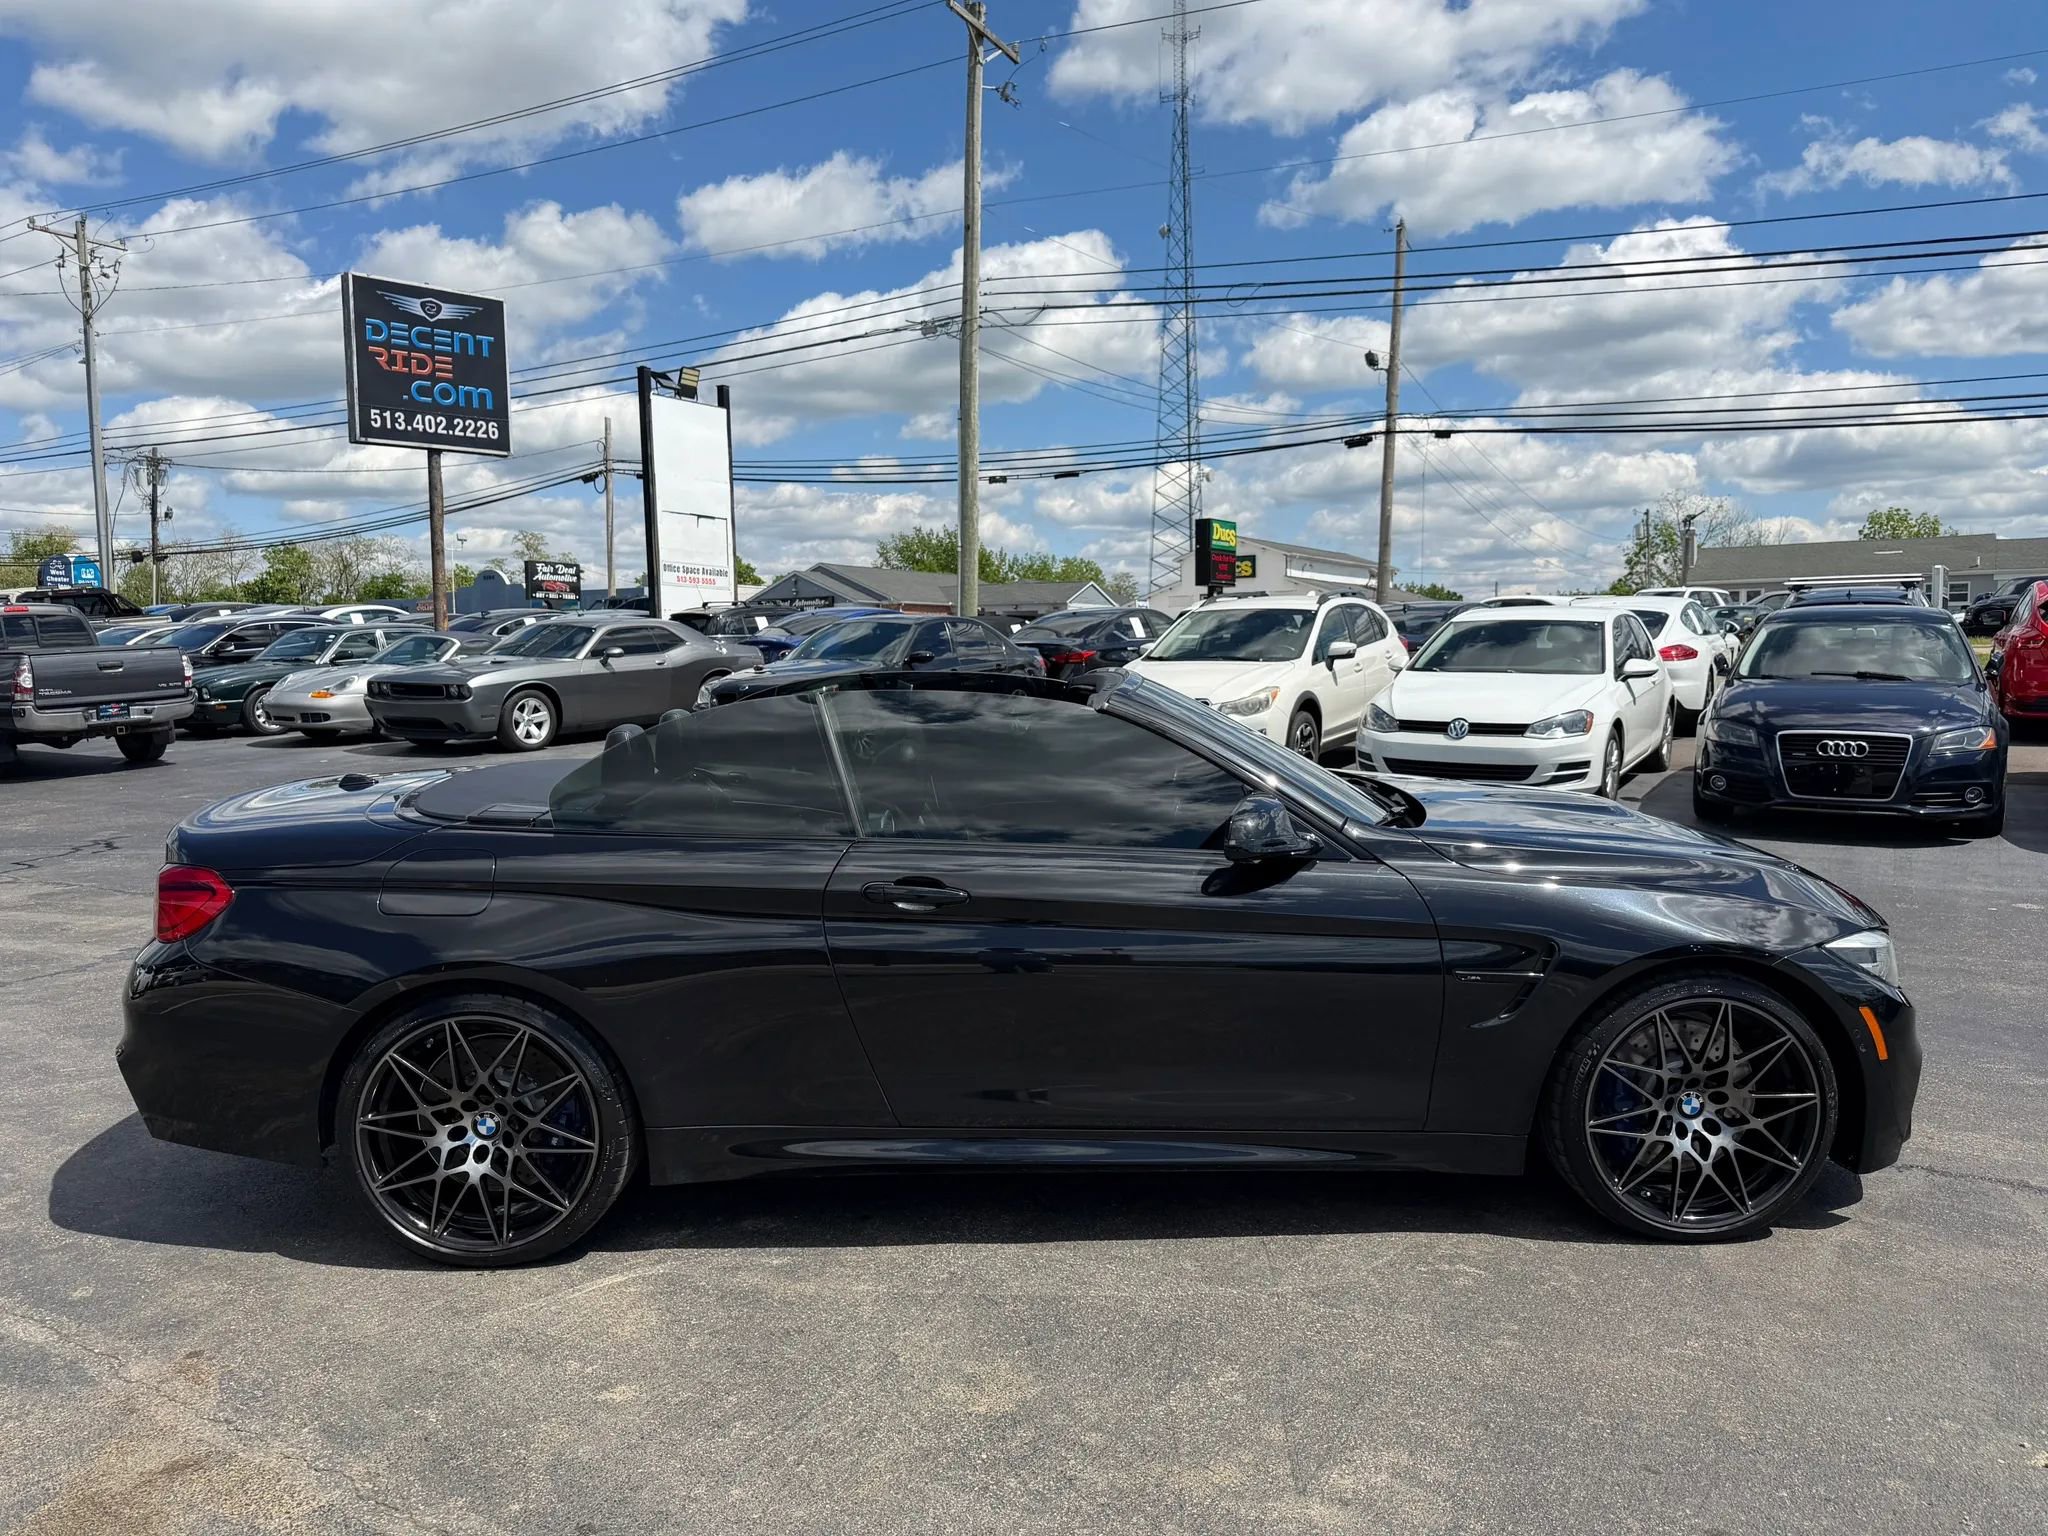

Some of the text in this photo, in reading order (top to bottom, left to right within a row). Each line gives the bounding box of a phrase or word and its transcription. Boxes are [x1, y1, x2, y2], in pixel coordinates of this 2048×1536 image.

[365, 317, 495, 358] DECENT
[368, 345, 454, 379] RIDE
[370, 408, 499, 440] 513.402.2226
[533, 571, 578, 583] Automotive
[535, 563, 577, 575] Fair Deal
[663, 563, 729, 578] Office Space Available
